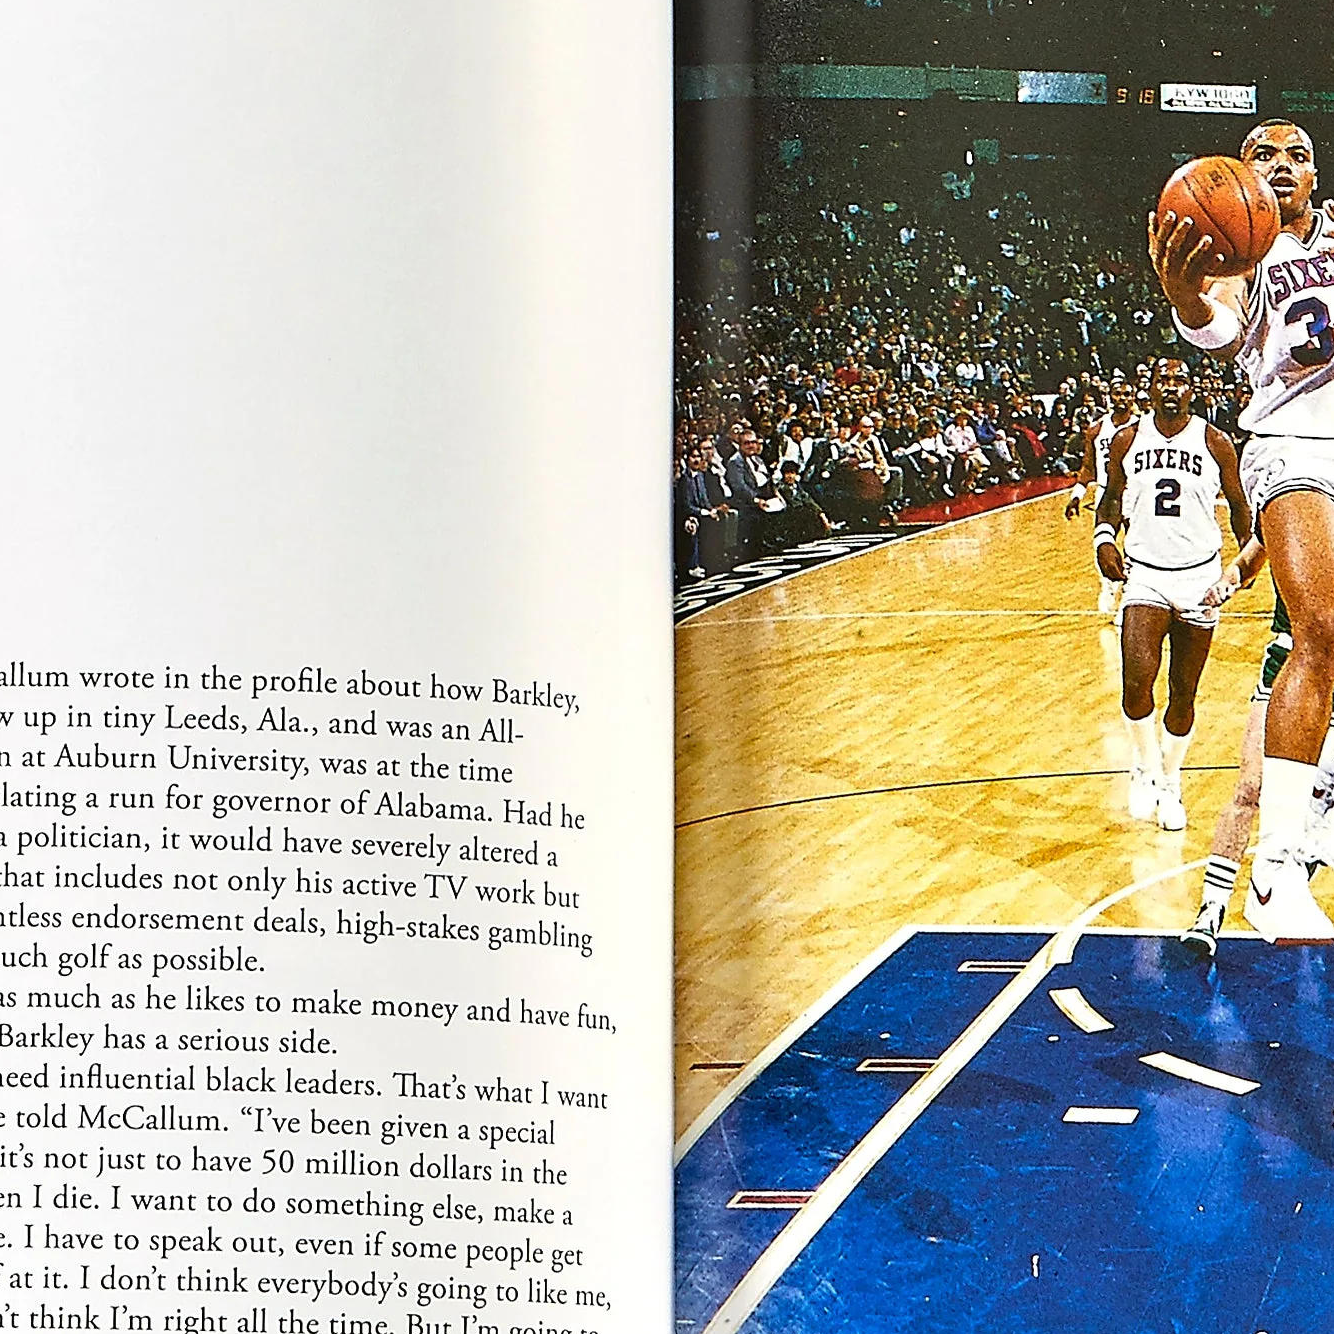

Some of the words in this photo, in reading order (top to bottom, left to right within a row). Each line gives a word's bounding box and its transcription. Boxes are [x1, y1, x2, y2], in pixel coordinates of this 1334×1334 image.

[1133, 448, 1203, 477] SIXERS
[1154, 478, 1181, 518] 2
[78, 671, 155, 689] wrote
[163, 665, 190, 690] in
[200, 663, 242, 691] the
[250, 666, 338, 700] profile
[346, 668, 422, 698] about
[429, 672, 484, 702] how
[491, 678, 580, 718] Barkley,
[21, 750, 46, 768] at
[53, 742, 157, 769] Auburn
[166, 744, 310, 781] University,
[318, 757, 368, 776] was
[376, 759, 401, 777] at
[409, 752, 450, 780] the
[458, 757, 513, 784] time
[85, 792, 100, 809] a
[108, 792, 155, 809] run
[164, 783, 204, 810] for
[212, 794, 332, 820] governor
[340, 788, 371, 816] of
[373, 790, 493, 823] Alabama.
[502, 798, 553, 827] Had
[560, 802, 585, 830] he
[71, 902, 245, 932] endorsement
[253, 906, 326, 938] deals,
[336, 908, 480, 945] high-stakes
[487, 919, 593, 959] gambling
[59, 1062, 196, 1091] influential
[205, 1065, 277, 1093] black
[284, 1067, 382, 1097] leaders.
[473, 1076, 533, 1104] what
[540, 1080, 550, 1105] I
[557, 1090, 608, 1110] want
[24, 1223, 34, 1249] I
[43, 1222, 104, 1250] have
[113, 1232, 140, 1251] to
[149, 1225, 224, 1260] speak
[232, 1235, 285, 1258] out,
[295, 1238, 355, 1256] even
[363, 1230, 387, 1257] if
[391, 1241, 457, 1260] some
[465, 1237, 544, 1271] people
[551, 1249, 584, 1274] get
